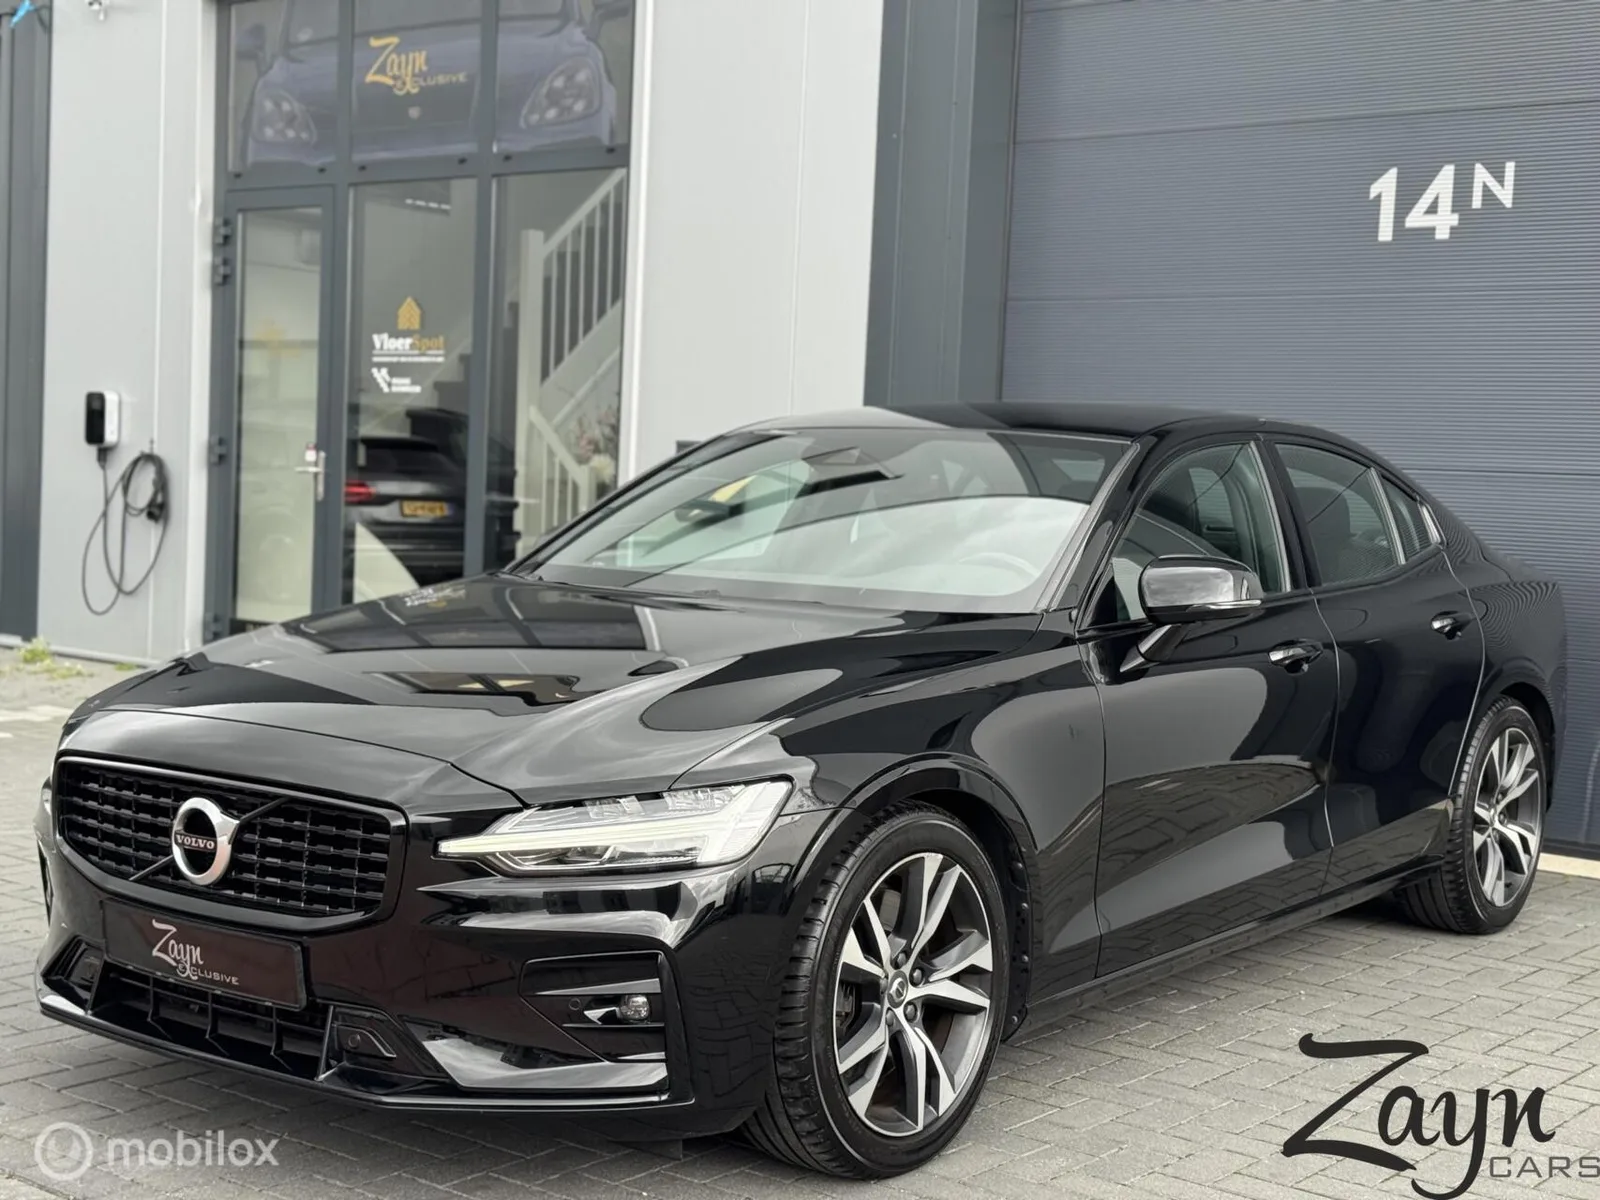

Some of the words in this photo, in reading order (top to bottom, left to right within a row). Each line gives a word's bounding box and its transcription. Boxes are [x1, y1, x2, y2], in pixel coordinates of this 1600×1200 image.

[365, 36, 428, 95] Zayn
[176, 834, 215, 849] VOLVO
[152, 919, 204, 980] Zayn
